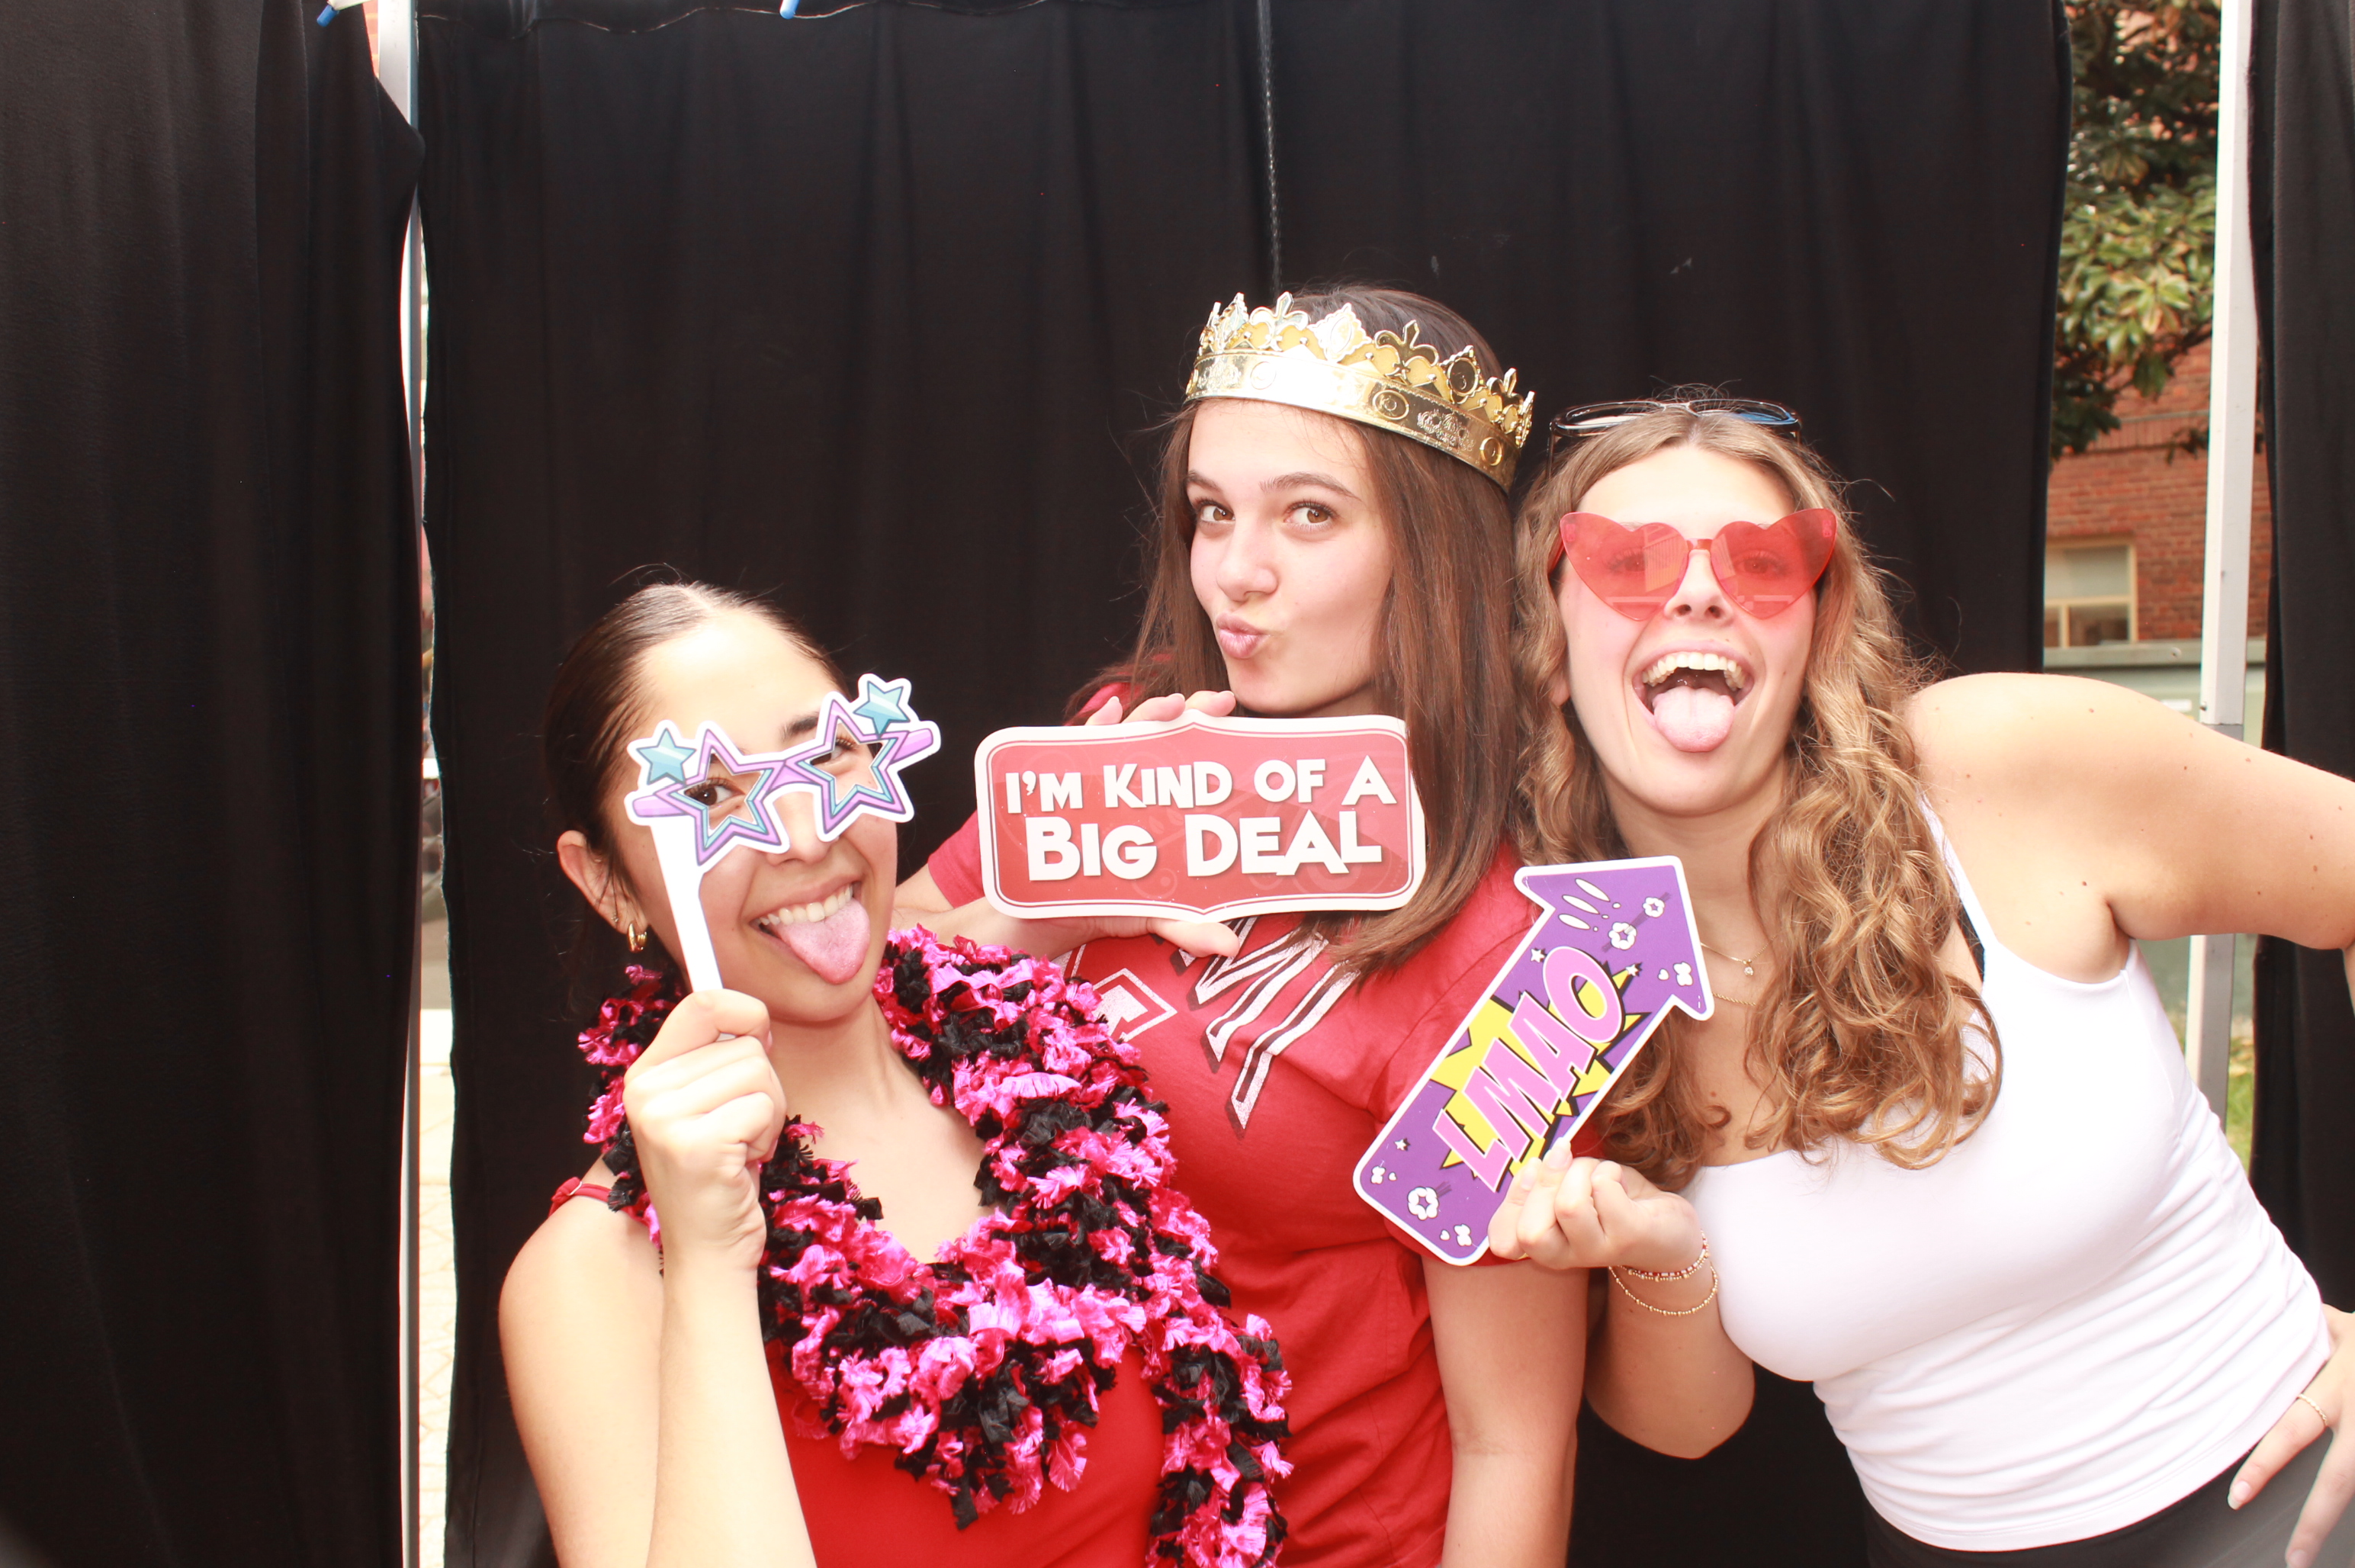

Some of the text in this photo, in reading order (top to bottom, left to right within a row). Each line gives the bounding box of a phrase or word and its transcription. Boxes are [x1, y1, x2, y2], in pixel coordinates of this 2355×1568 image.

[1005, 754, 1397, 814] I'M KIND OF A
[1025, 809, 1382, 881] BIG DEAL
[1431, 945, 1624, 1194] LMAO
